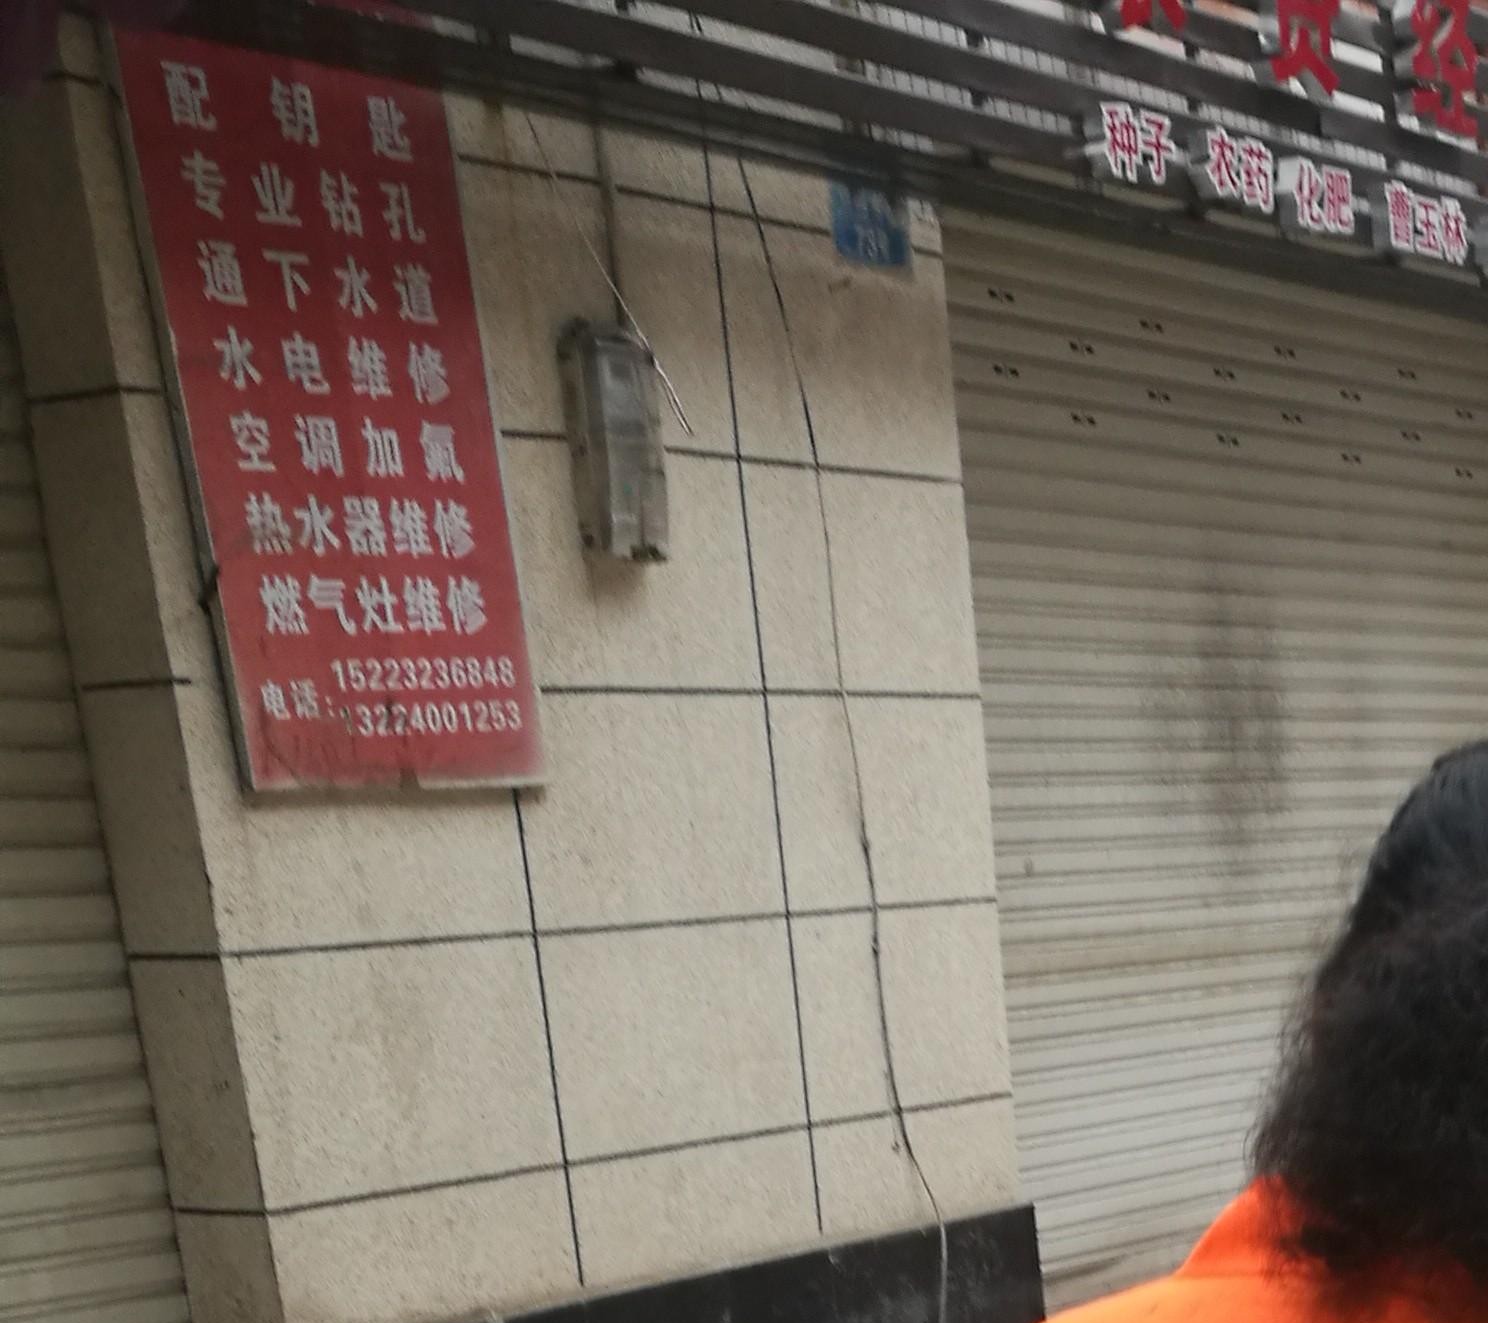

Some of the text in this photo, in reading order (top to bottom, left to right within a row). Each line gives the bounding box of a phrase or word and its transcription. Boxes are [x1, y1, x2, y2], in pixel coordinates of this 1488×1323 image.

[159, 59, 415, 164] 配钥匙
[180, 148, 428, 244] 专业钻孔
[1099, 100, 1177, 186] 种子
[1205, 125, 1275, 215] 农药
[1294, 155, 1355, 235] 化肥
[197, 239, 439, 326] 通下水道
[212, 324, 451, 405] 水电维修
[228, 409, 466, 486] 空调加氟
[244, 491, 477, 560] 热水器维修
[258, 573, 489, 636] 燃气灶维修
[331, 655, 516, 693] 15223236848
[339, 698, 523, 738] 13224001253
